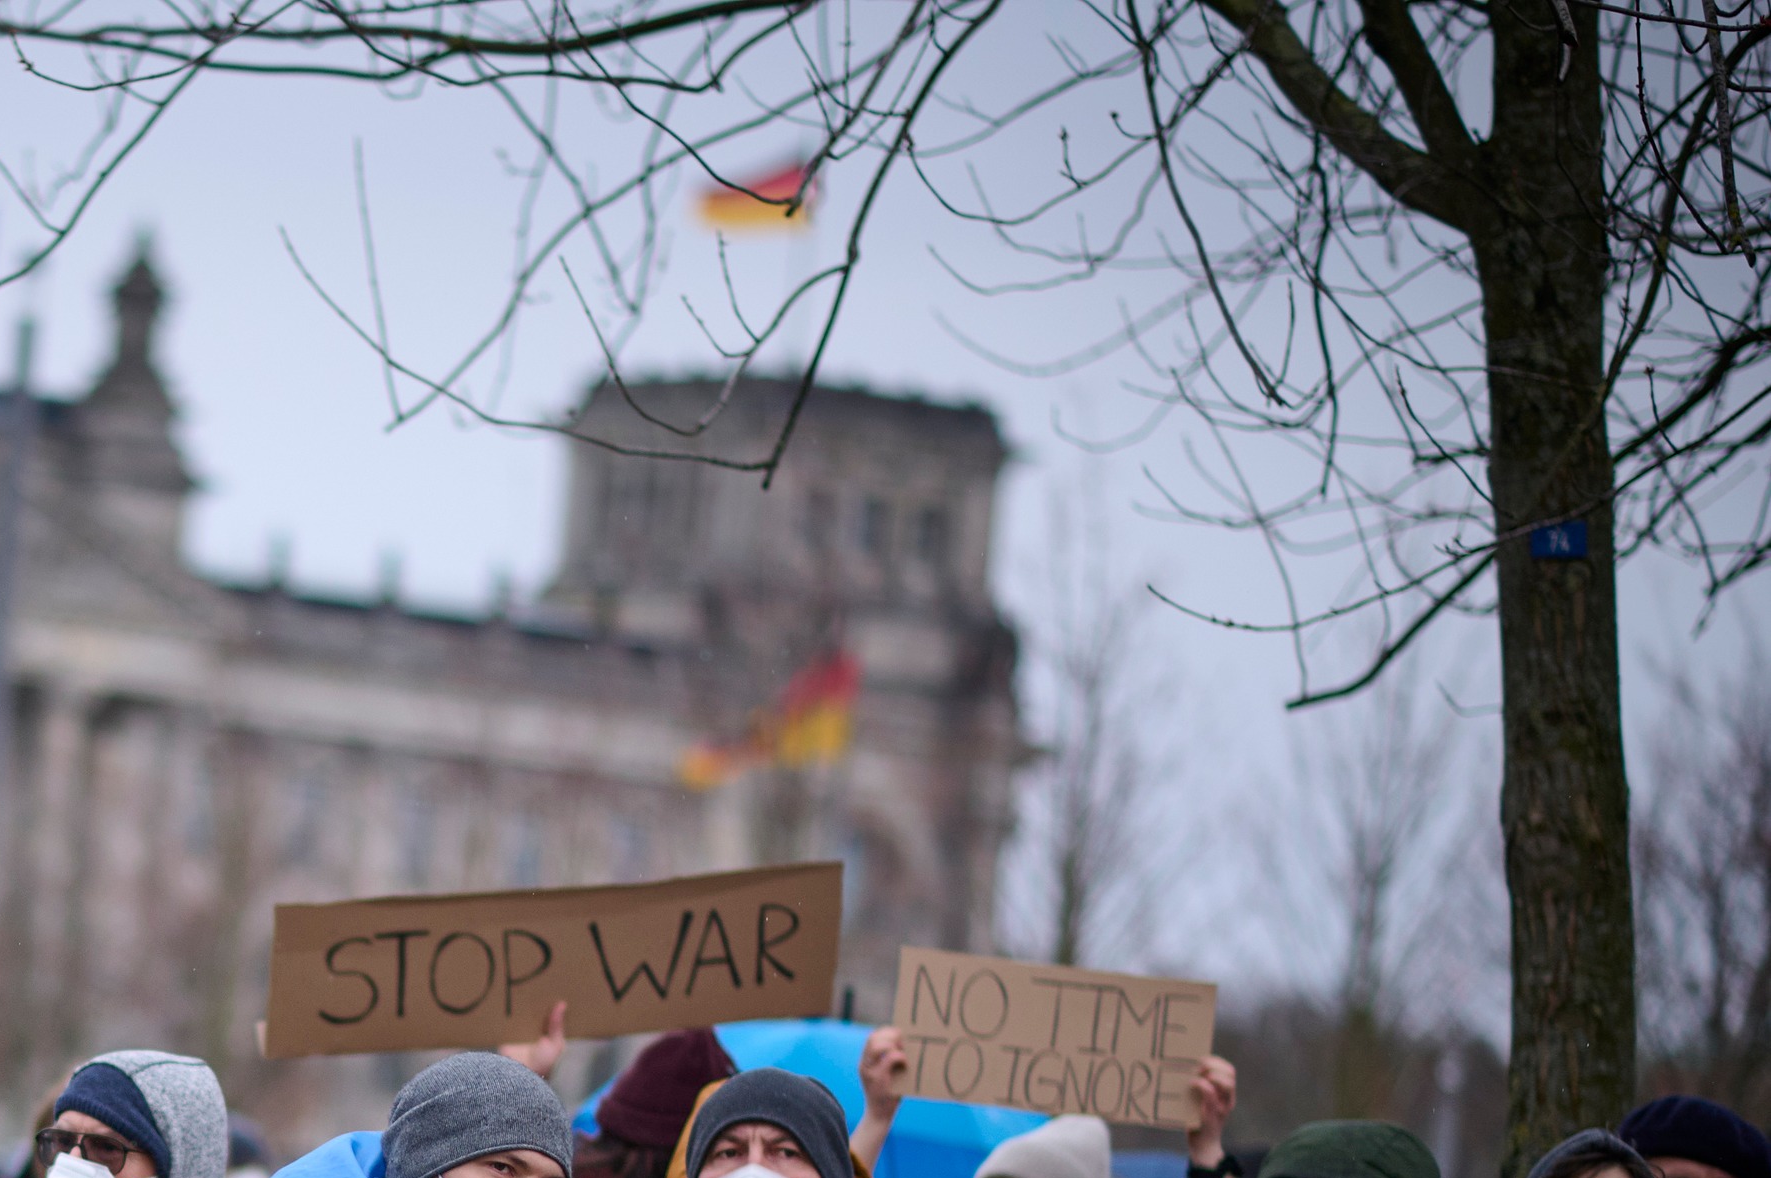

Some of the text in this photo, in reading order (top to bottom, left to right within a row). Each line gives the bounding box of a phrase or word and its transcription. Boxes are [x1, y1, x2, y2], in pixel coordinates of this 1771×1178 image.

[319, 902, 800, 1025] STOP WAR
[911, 964, 1202, 1060] NO TIME
[907, 1035, 1202, 1126] TO IGNORE
